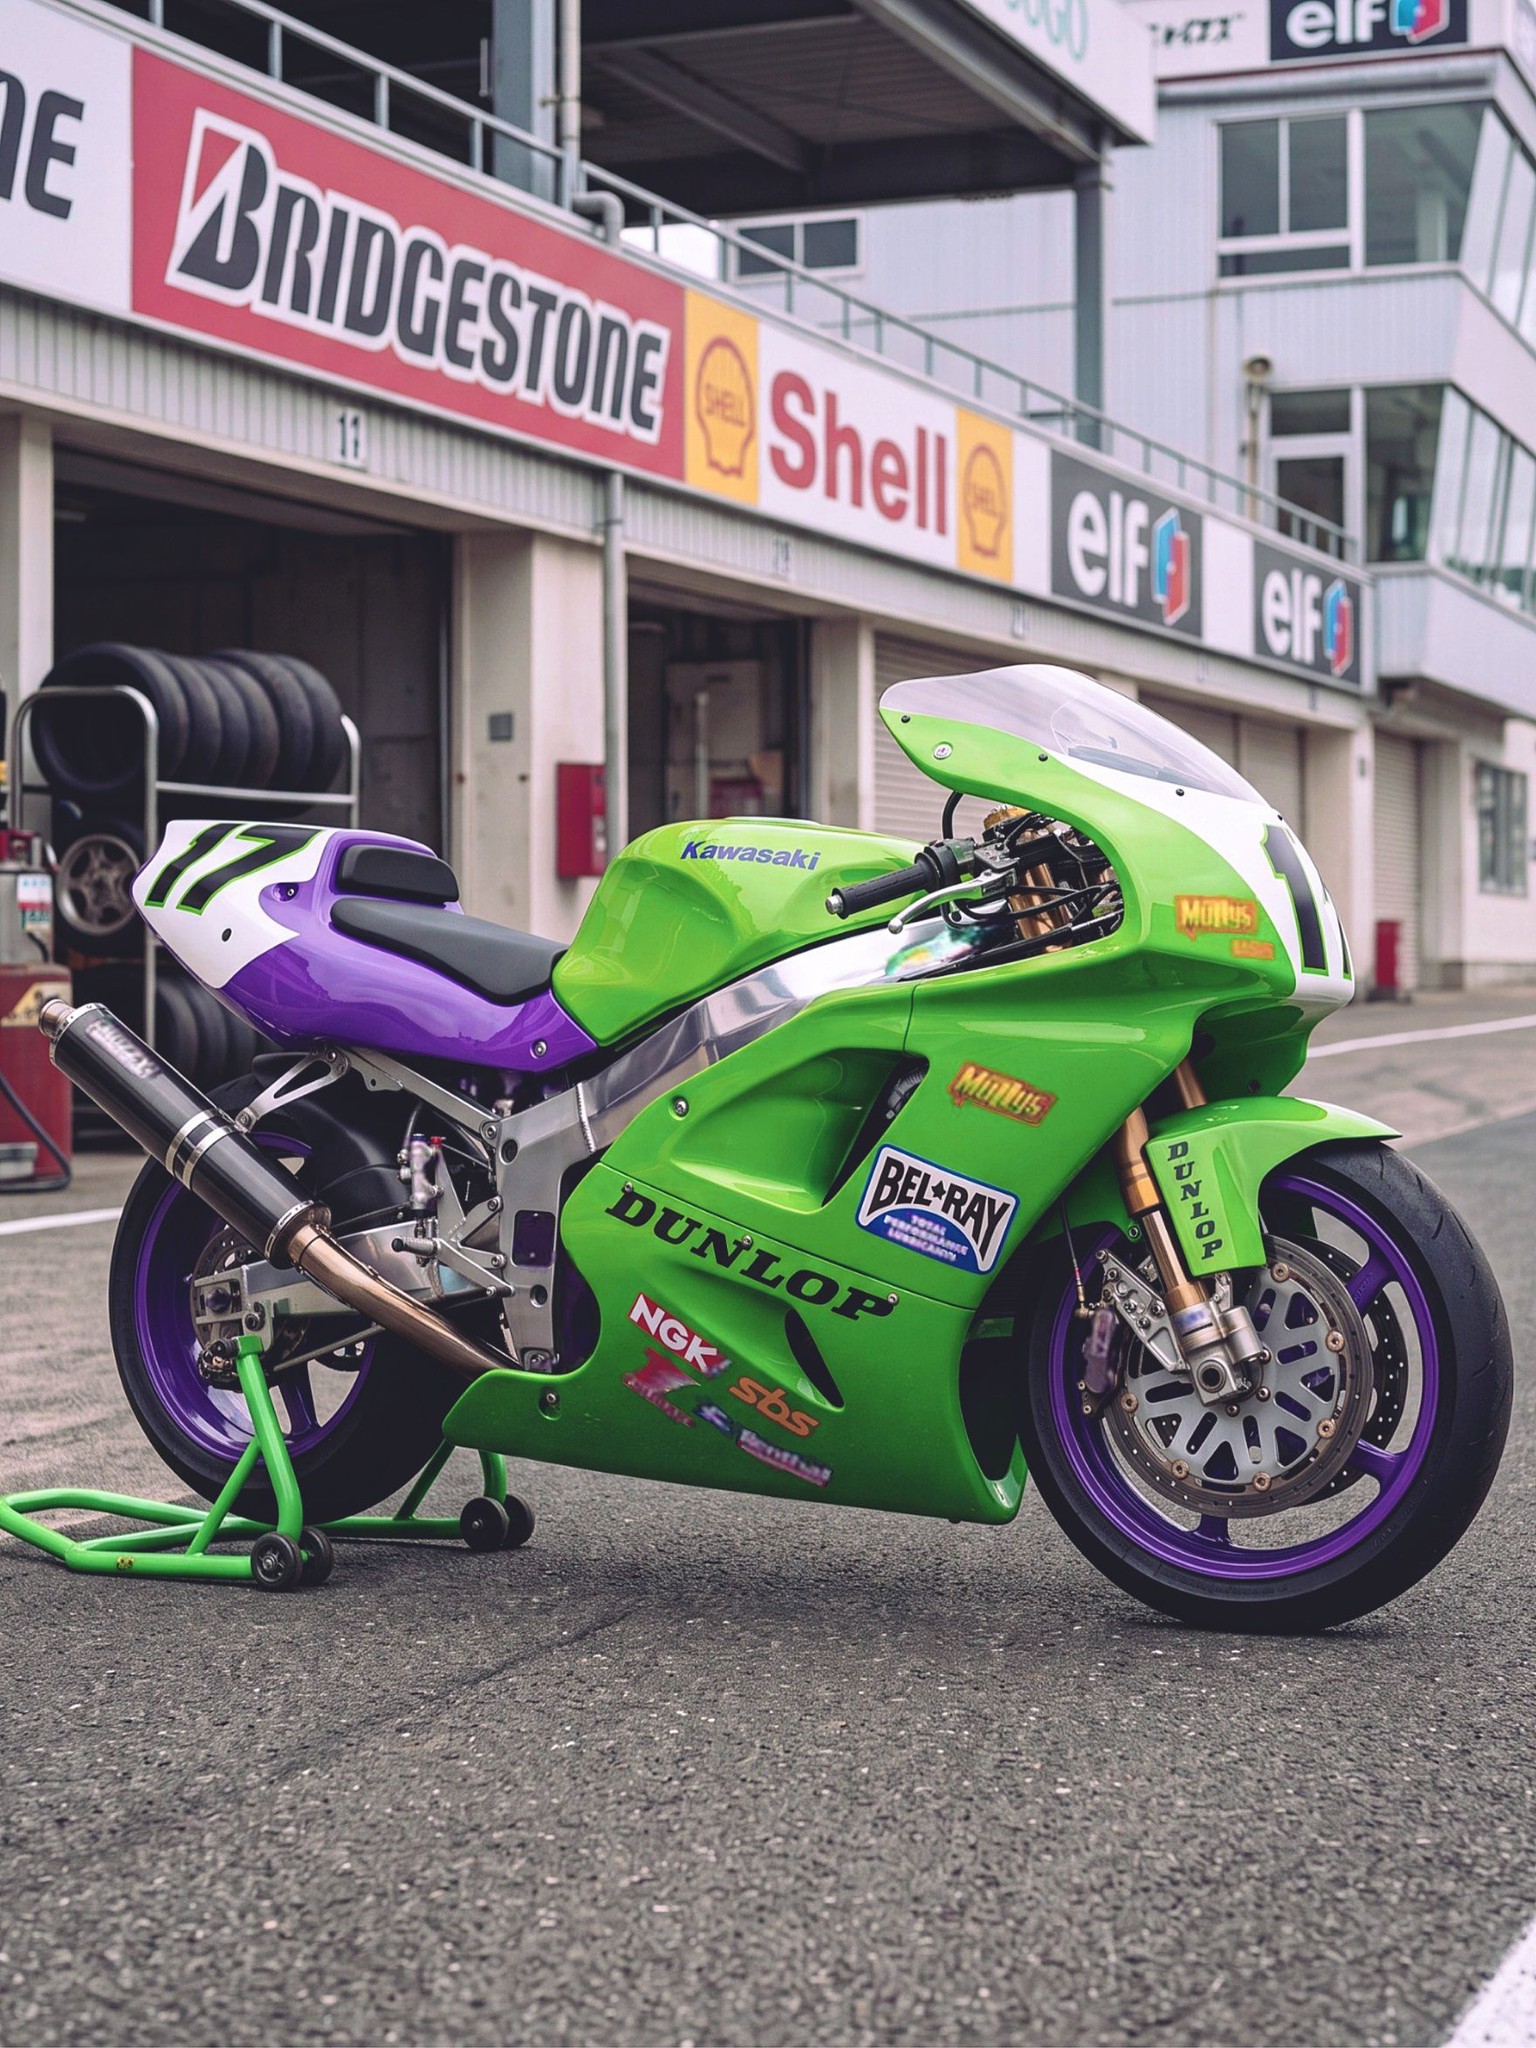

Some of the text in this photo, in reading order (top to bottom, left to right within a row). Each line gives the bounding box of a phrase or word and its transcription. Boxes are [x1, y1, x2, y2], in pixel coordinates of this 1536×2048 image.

[1286, 0, 1387, 48] elf
[176, 126, 664, 432] BRIDGESTONE
[769, 370, 946, 536] Shell
[1068, 490, 1149, 607] elf
[1262, 568, 1322, 664] elf
[144, 823, 326, 916] 17
[680, 840, 821, 871] Kawasaki
[1259, 823, 1353, 980] 1
[605, 1183, 896, 1321] DUNLOP
[1167, 1140, 1223, 1260] DUNLOP
[629, 1293, 717, 1374] NGK
[729, 1376, 820, 1437] sbs
